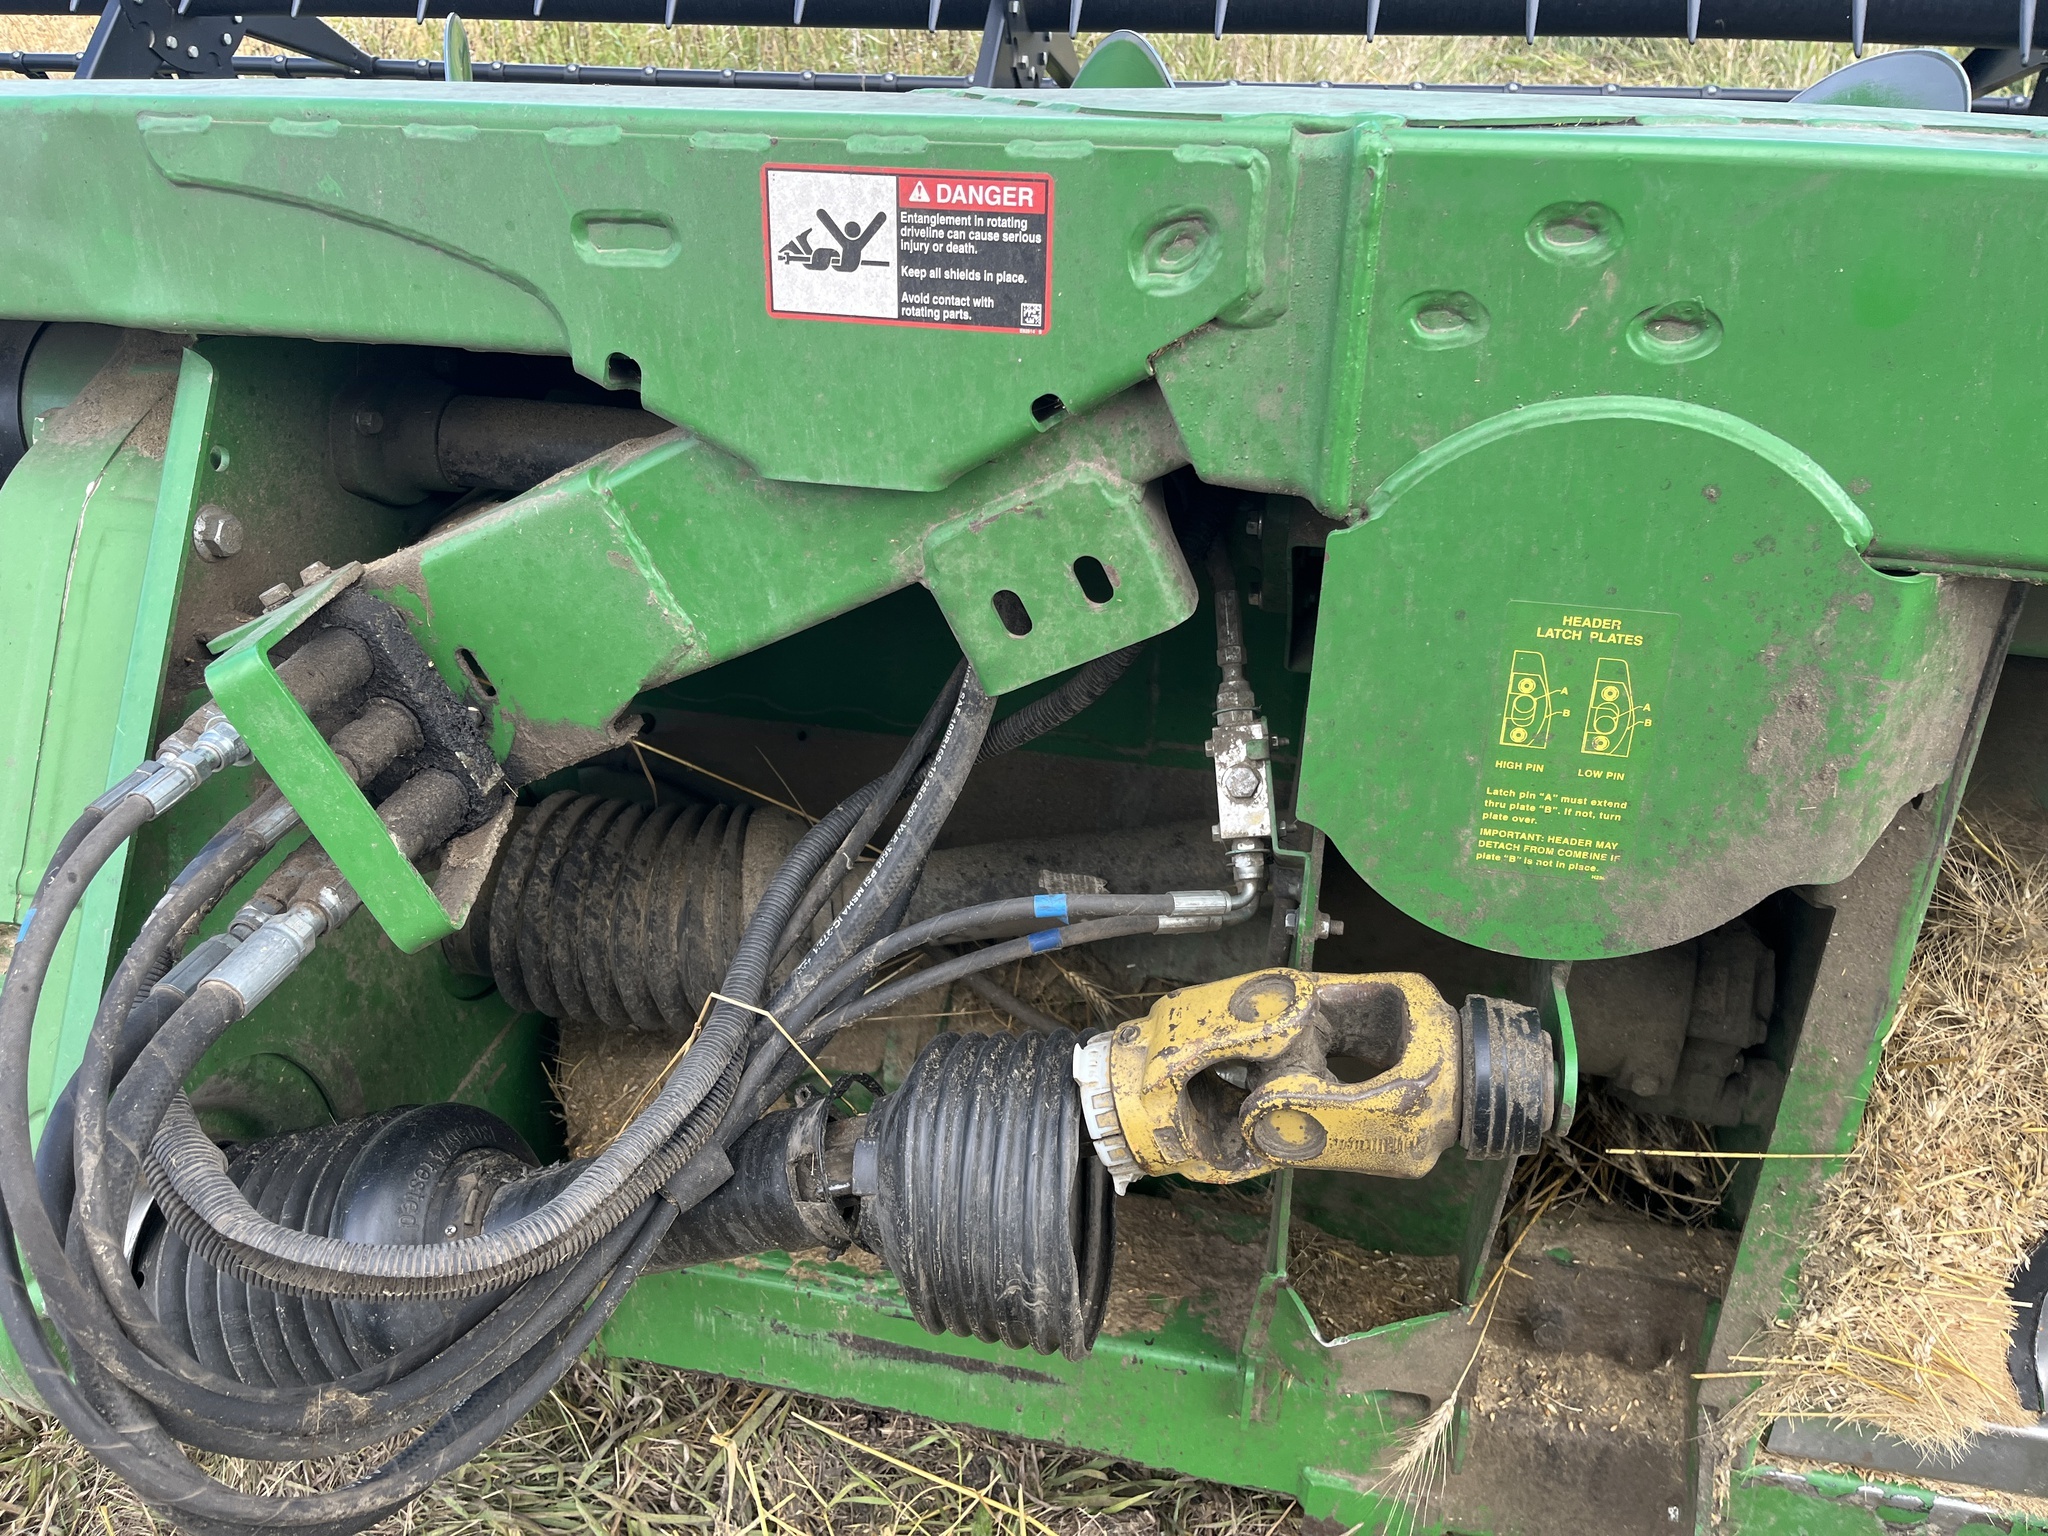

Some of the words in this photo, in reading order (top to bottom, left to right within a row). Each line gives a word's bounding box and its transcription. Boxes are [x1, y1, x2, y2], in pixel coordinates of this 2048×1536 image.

[937, 184, 1033, 207] DANGER
[900, 212, 971, 226] Entanglement
[975, 215, 983, 226] in
[987, 216, 1027, 230] rotating
[901, 226, 944, 238] driveline
[947, 230, 965, 240] can
[969, 231, 999, 241] cause
[1002, 231, 1041, 243] serious
[901, 239, 929, 254] injury
[932, 243, 943, 252] or
[946, 242, 977, 254] death.
[901, 266, 926, 280] Keep
[930, 268, 941, 279] all
[944, 268, 980, 281] shields
[984, 270, 993, 281] in
[996, 271, 1027, 285] place.
[901, 292, 929, 304] Avoid
[932, 295, 970, 306] contact
[973, 296, 994, 308] with
[901, 306, 940, 320] rotating
[943, 309, 972, 321] parts.
[1563, 616, 1622, 630] HEADER
[1537, 627, 1582, 640] LATCH
[1590, 632, 1643, 646] PLATES
[1560, 687, 1568, 695] A
[954, 692, 965, 716] SAE
[1562, 709, 1570, 717] B
[1643, 704, 1650, 712] A
[1644, 719, 1652, 727] B
[1495, 760, 1522, 770] HIGH
[1526, 763, 1544, 772] PIN
[1578, 769, 1603, 778] LOW
[1606, 772, 1625, 780] PIN
[917, 779, 929, 801] 2SC
[1486, 787, 1515, 797] Latch
[1519, 791, 1536, 803] pin
[1561, 796, 1587, 805] must
[1591, 799, 1627, 809] extend
[1482, 812, 1508, 821] plate
[1512, 816, 1537, 824] over.
[1485, 800, 1506, 809] thru
[1509, 802, 1536, 812] plate
[1575, 810, 1595, 819] not,
[1599, 812, 1621, 821] turn
[1480, 828, 1544, 842] IMPORTANT:
[1548, 836, 1592, 847] HEADER
[1596, 841, 1618, 850] MAY
[1478, 840, 1520, 851] DETACH
[1524, 845, 1554, 855] FROM
[1557, 849, 1607, 860] COMBINE
[1476, 853, 1501, 861] plate
[1524, 857, 1532, 865] is
[1536, 858, 1552, 867] not
[1568, 863, 1598, 872] place.
[864, 869, 877, 887] PSI
[842, 887, 864, 916] MSHA
